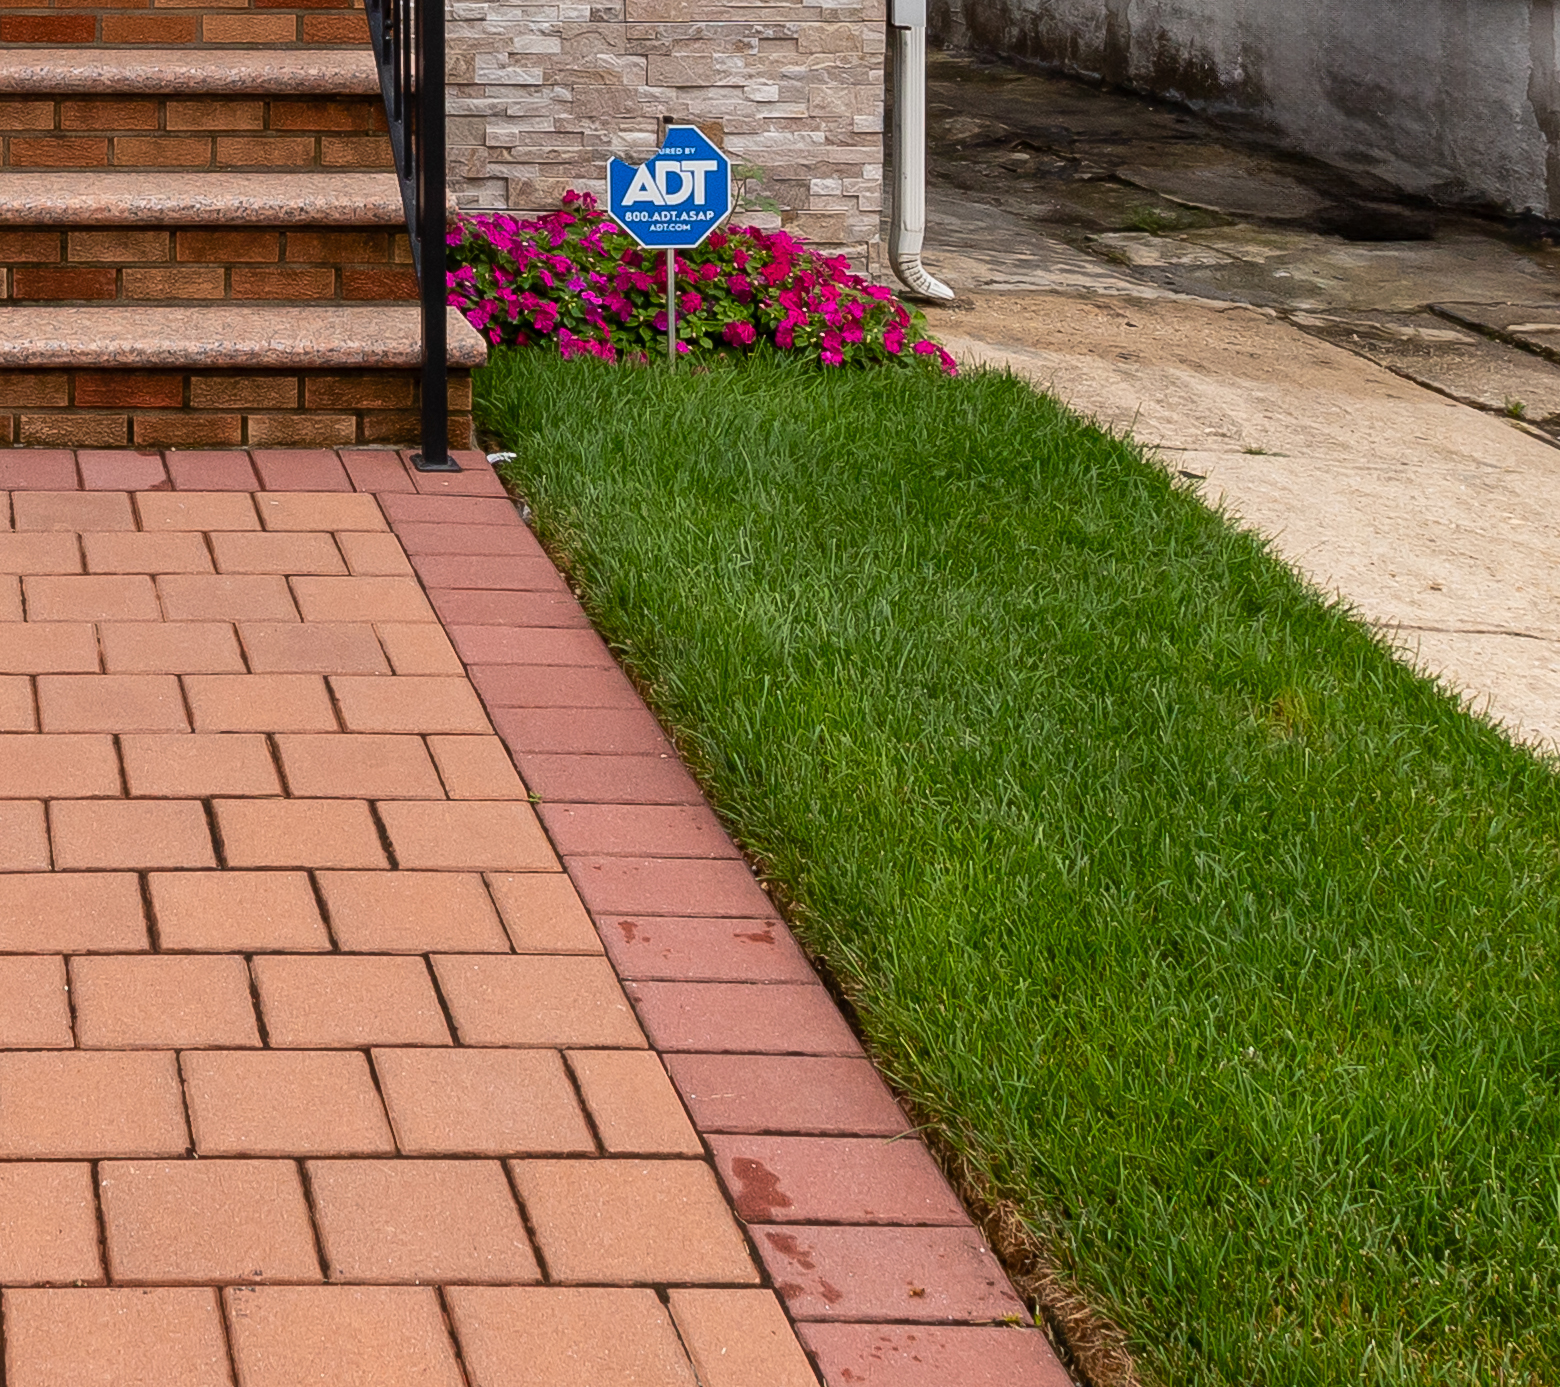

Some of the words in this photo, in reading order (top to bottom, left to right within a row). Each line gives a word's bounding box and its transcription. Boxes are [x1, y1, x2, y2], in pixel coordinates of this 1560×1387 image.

[684, 147, 696, 155] BY
[621, 160, 718, 206] ADT
[625, 211, 714, 222] 800.ADT.ASAP
[649, 224, 691, 232] ADT.COM
